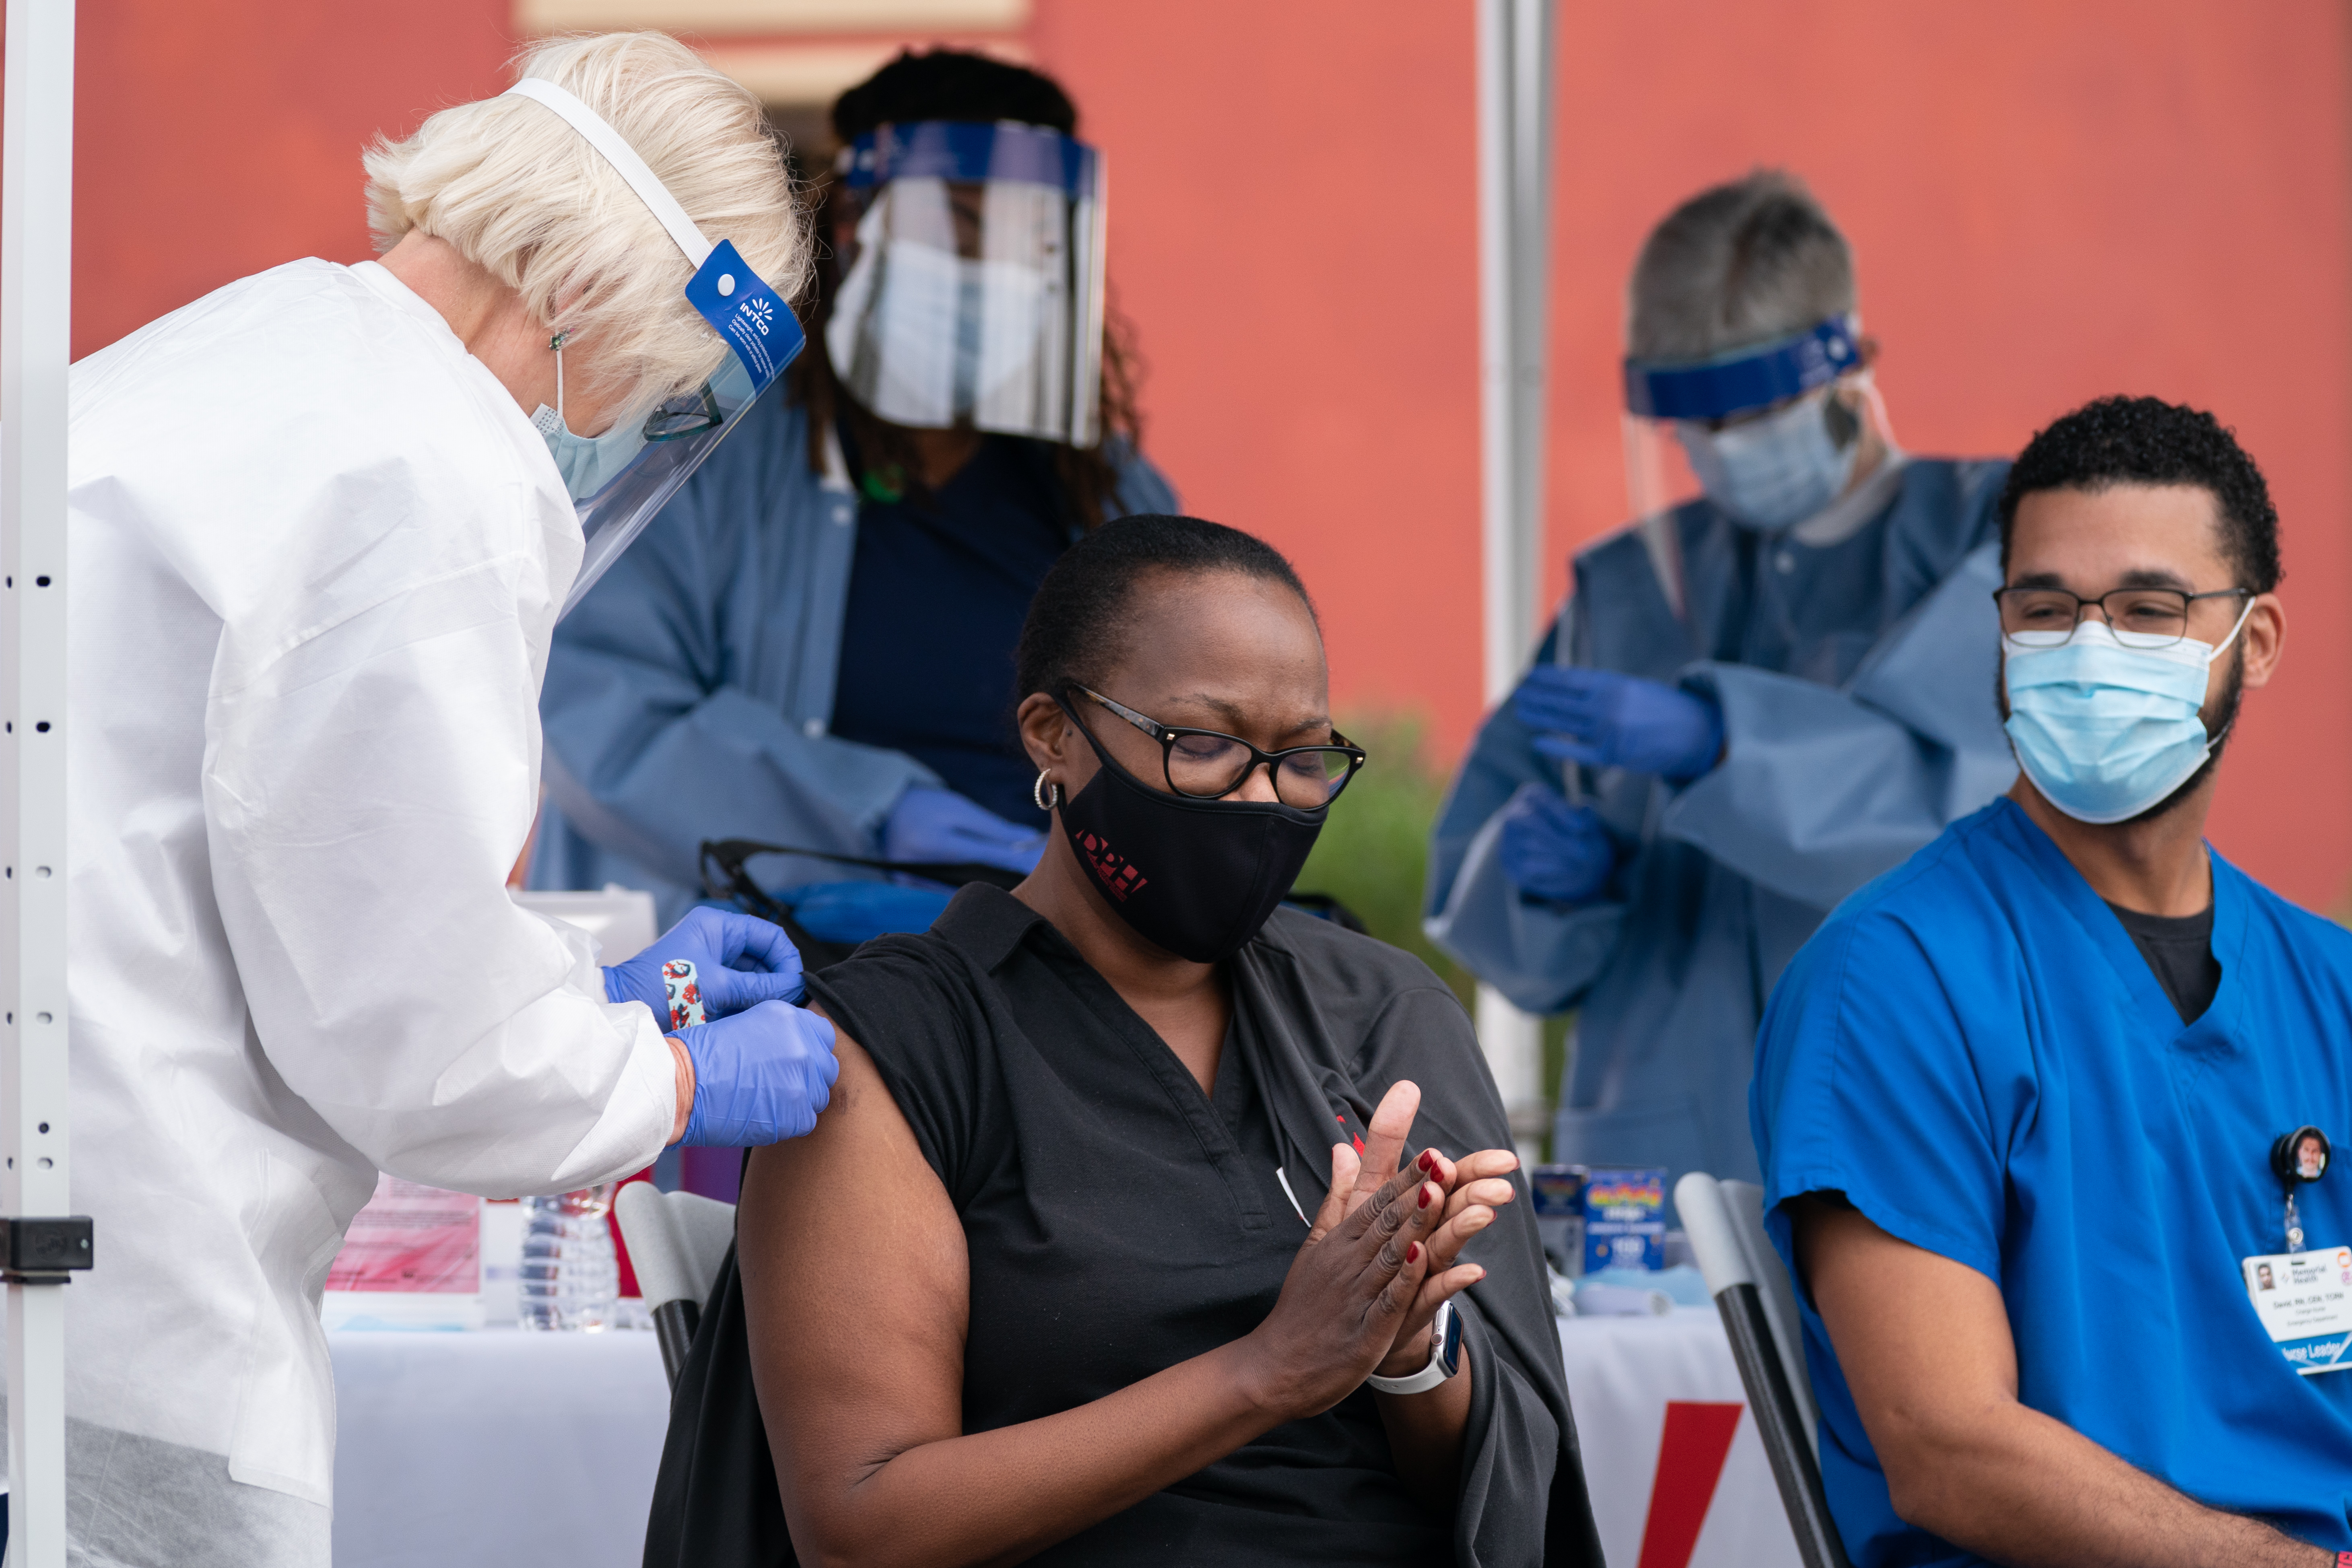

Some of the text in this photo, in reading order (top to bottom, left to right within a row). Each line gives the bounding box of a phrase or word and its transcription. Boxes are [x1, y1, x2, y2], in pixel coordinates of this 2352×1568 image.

[732, 319, 746, 334] Optically
[740, 303, 769, 336] INTCO
[735, 313, 753, 334] Lightweight,
[752, 333, 761, 345] anti-fog
[2292, 1264, 2327, 1276] Memorial
[2294, 1273, 2318, 1284] Health
[2308, 1341, 2340, 1358] Leader
